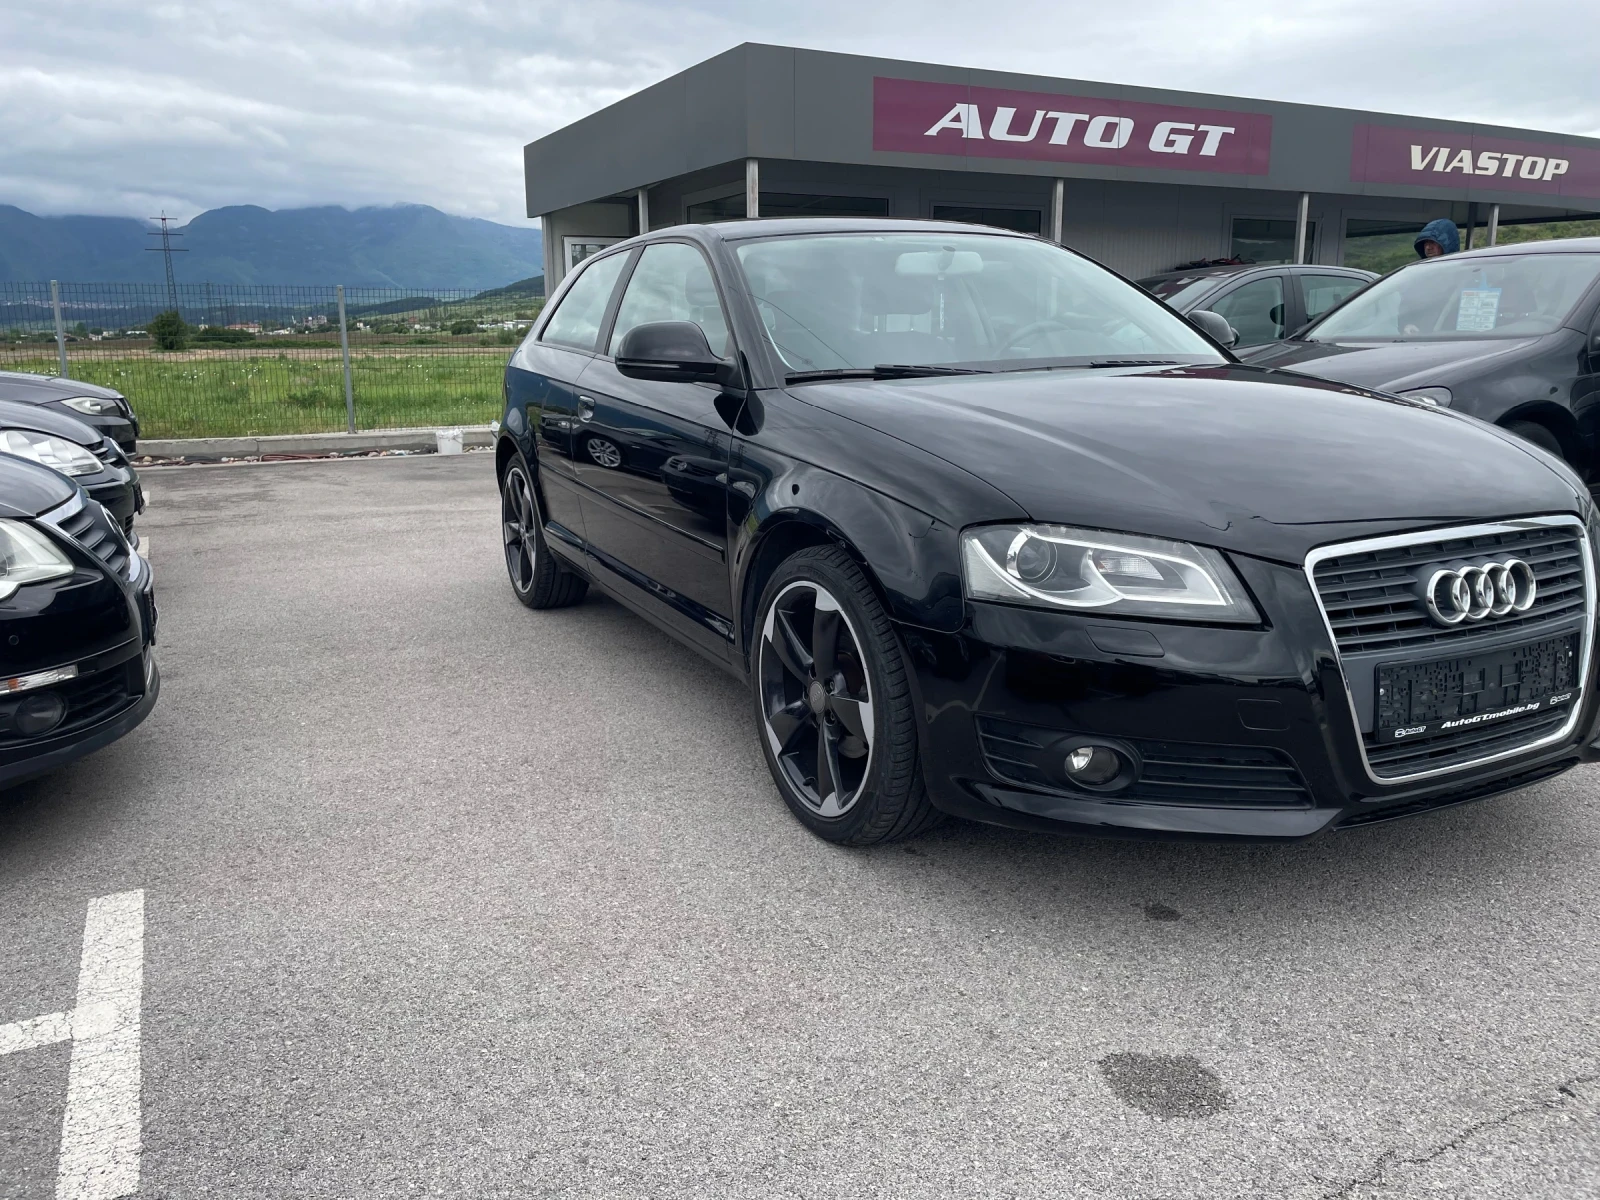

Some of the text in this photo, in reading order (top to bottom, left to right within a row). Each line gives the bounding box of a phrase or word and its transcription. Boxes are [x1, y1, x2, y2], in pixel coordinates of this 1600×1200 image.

[924, 102, 1235, 157] AUTO GT
[1410, 144, 1570, 181] VIASTOP
